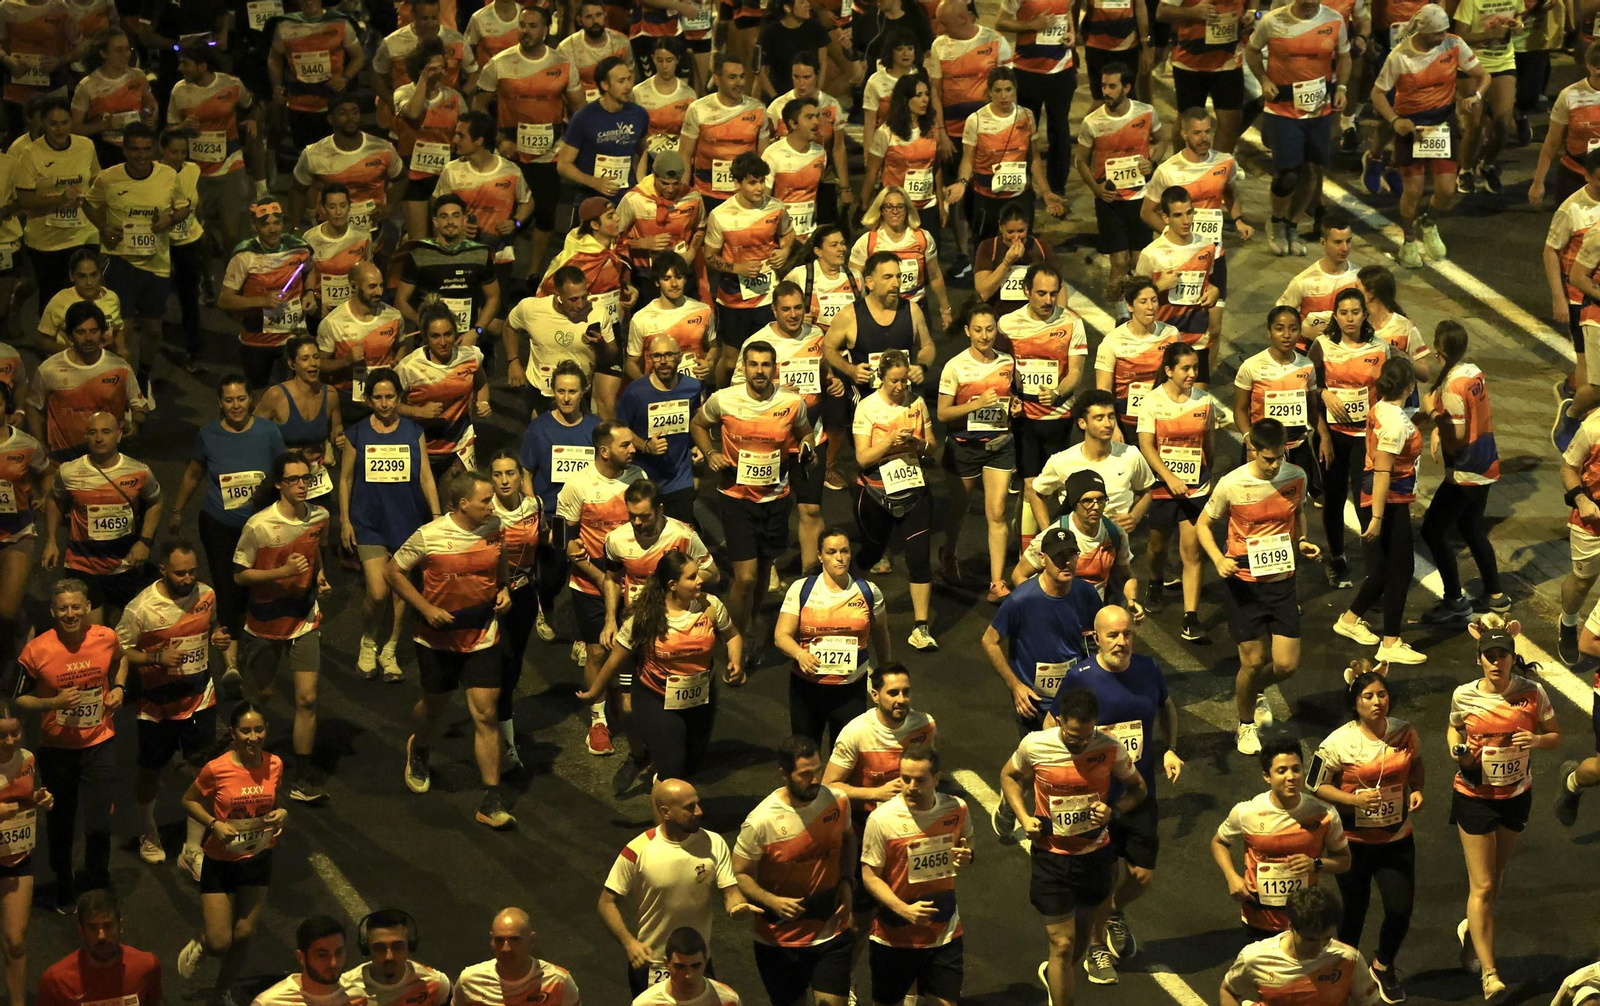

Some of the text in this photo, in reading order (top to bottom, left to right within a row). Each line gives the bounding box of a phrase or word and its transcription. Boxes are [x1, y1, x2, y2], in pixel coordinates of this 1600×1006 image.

[301, 64, 323, 75] 8440
[521, 136, 549, 146] 11233
[1419, 139, 1445, 149] 13860
[192, 143, 221, 153] 20234
[416, 153, 445, 166] 11244
[997, 175, 1021, 185] 18286
[1113, 168, 1136, 180] 2176
[1191, 222, 1218, 233] 17686
[131, 235, 155, 246] 1609
[745, 273, 772, 287] 24607
[268, 313, 298, 325] 24136
[784, 371, 814, 384] 14270
[1020, 373, 1053, 385] 21016
[972, 409, 1003, 421] 14273
[1269, 405, 1302, 416] 22919
[653, 414, 685, 427] 22405
[370, 460, 404, 471] 22399
[746, 465, 772, 477] 7958
[1163, 461, 1196, 474] 22980
[886, 466, 918, 482] 14054
[227, 485, 258, 500] 1861
[93, 517, 128, 530] 14659
[1253, 550, 1288, 564] 16199
[816, 652, 851, 665] 21274
[66, 660, 91, 671] XXXV
[675, 687, 701, 700] 1030
[1491, 760, 1520, 774] 7192
[240, 786, 264, 796] XXXV
[913, 854, 949, 870] 24656
[1262, 881, 1302, 893] 11322
